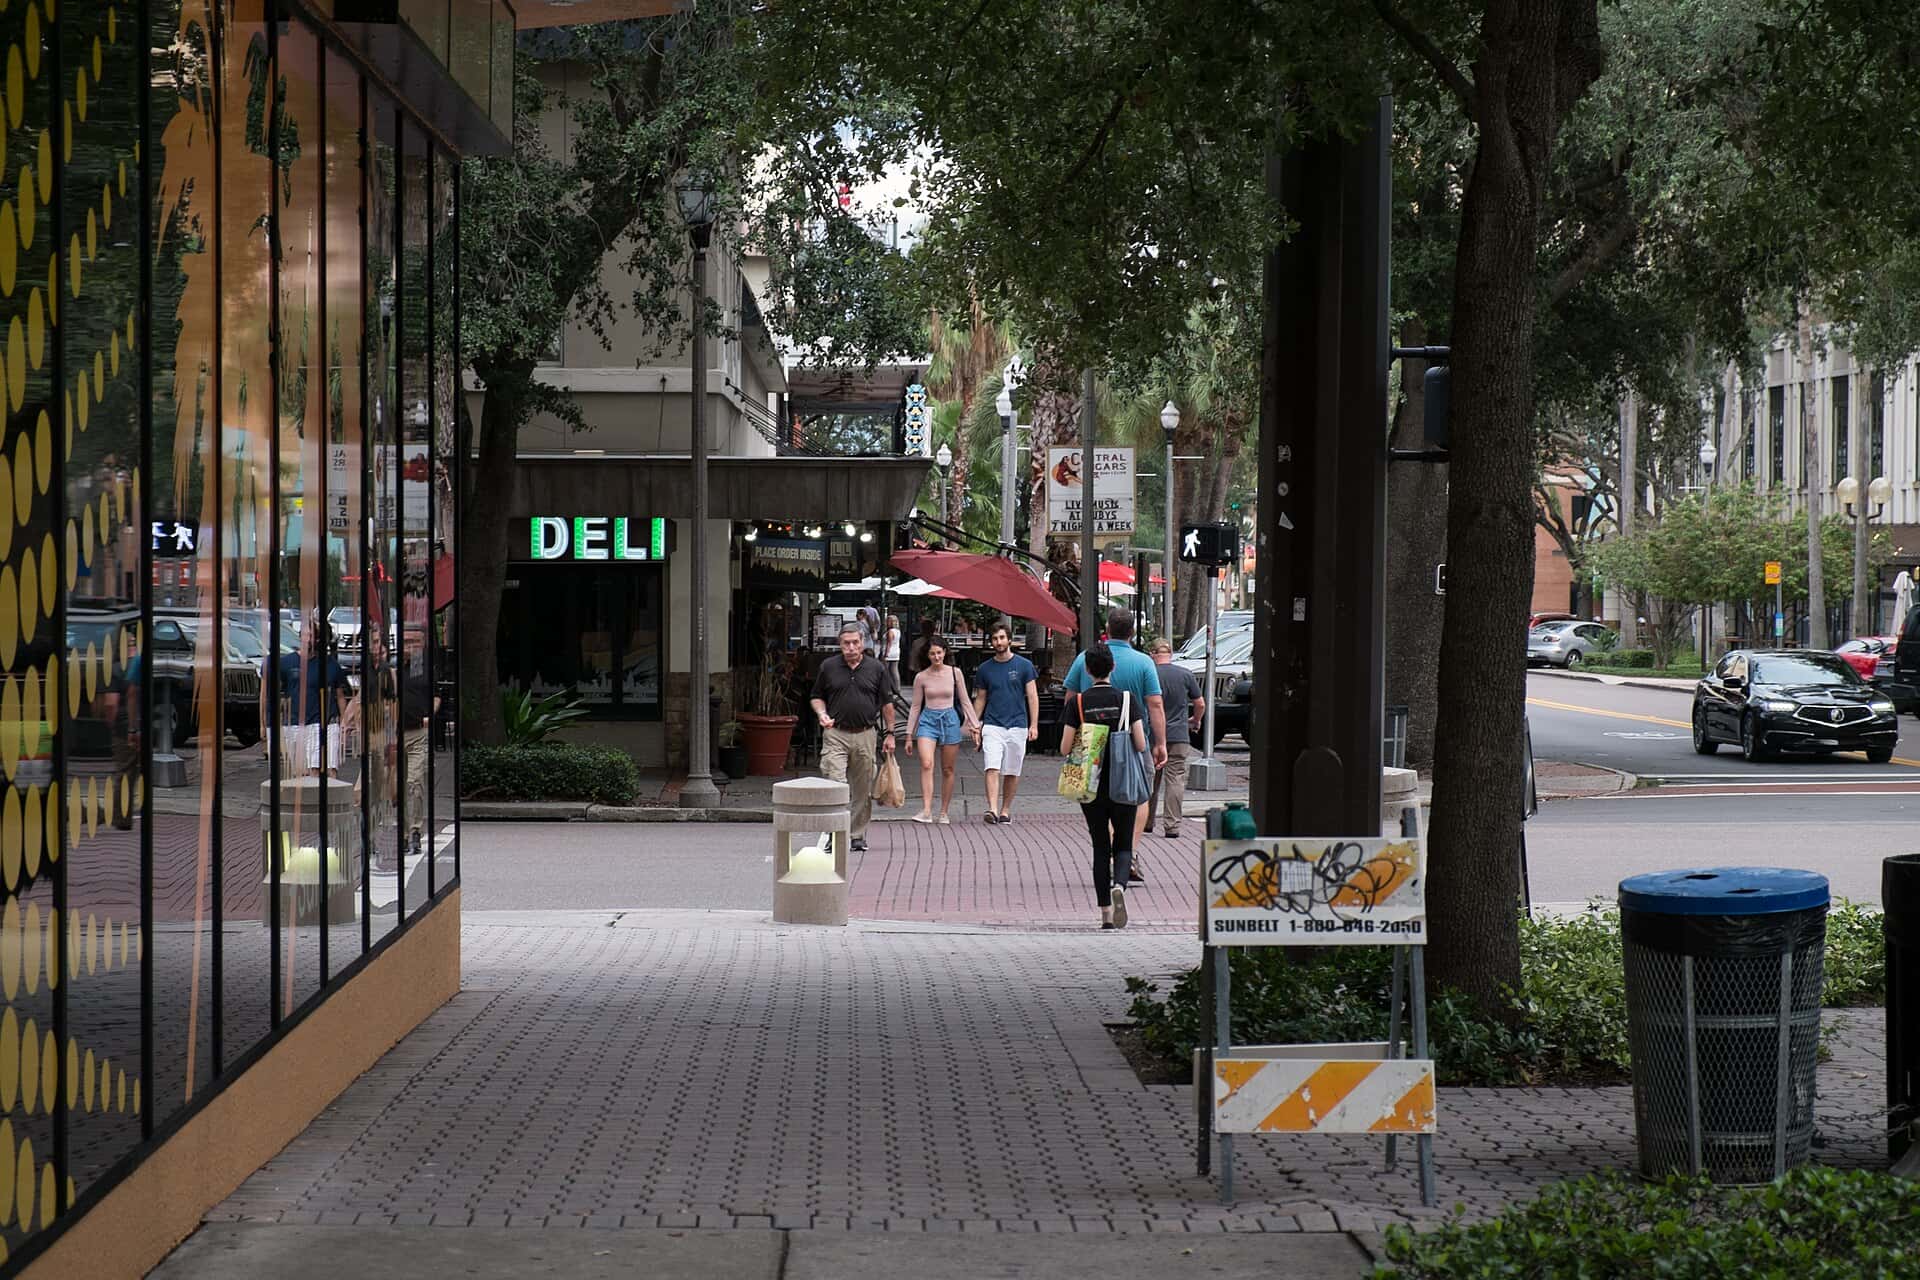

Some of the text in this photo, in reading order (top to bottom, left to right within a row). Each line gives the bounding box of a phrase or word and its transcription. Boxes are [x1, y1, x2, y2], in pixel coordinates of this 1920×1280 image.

[1071, 452, 1127, 465] CTRAL
[1065, 500, 1081, 510] LIV
[1093, 511, 1117, 520] UBYS
[1051, 521, 1132, 532] 7 NIGH A WEEK
[530, 516, 665, 560] DELI
[755, 545, 822, 561] PLACE ORDER INSIDE
[1214, 919, 1280, 933] SUNBELT
